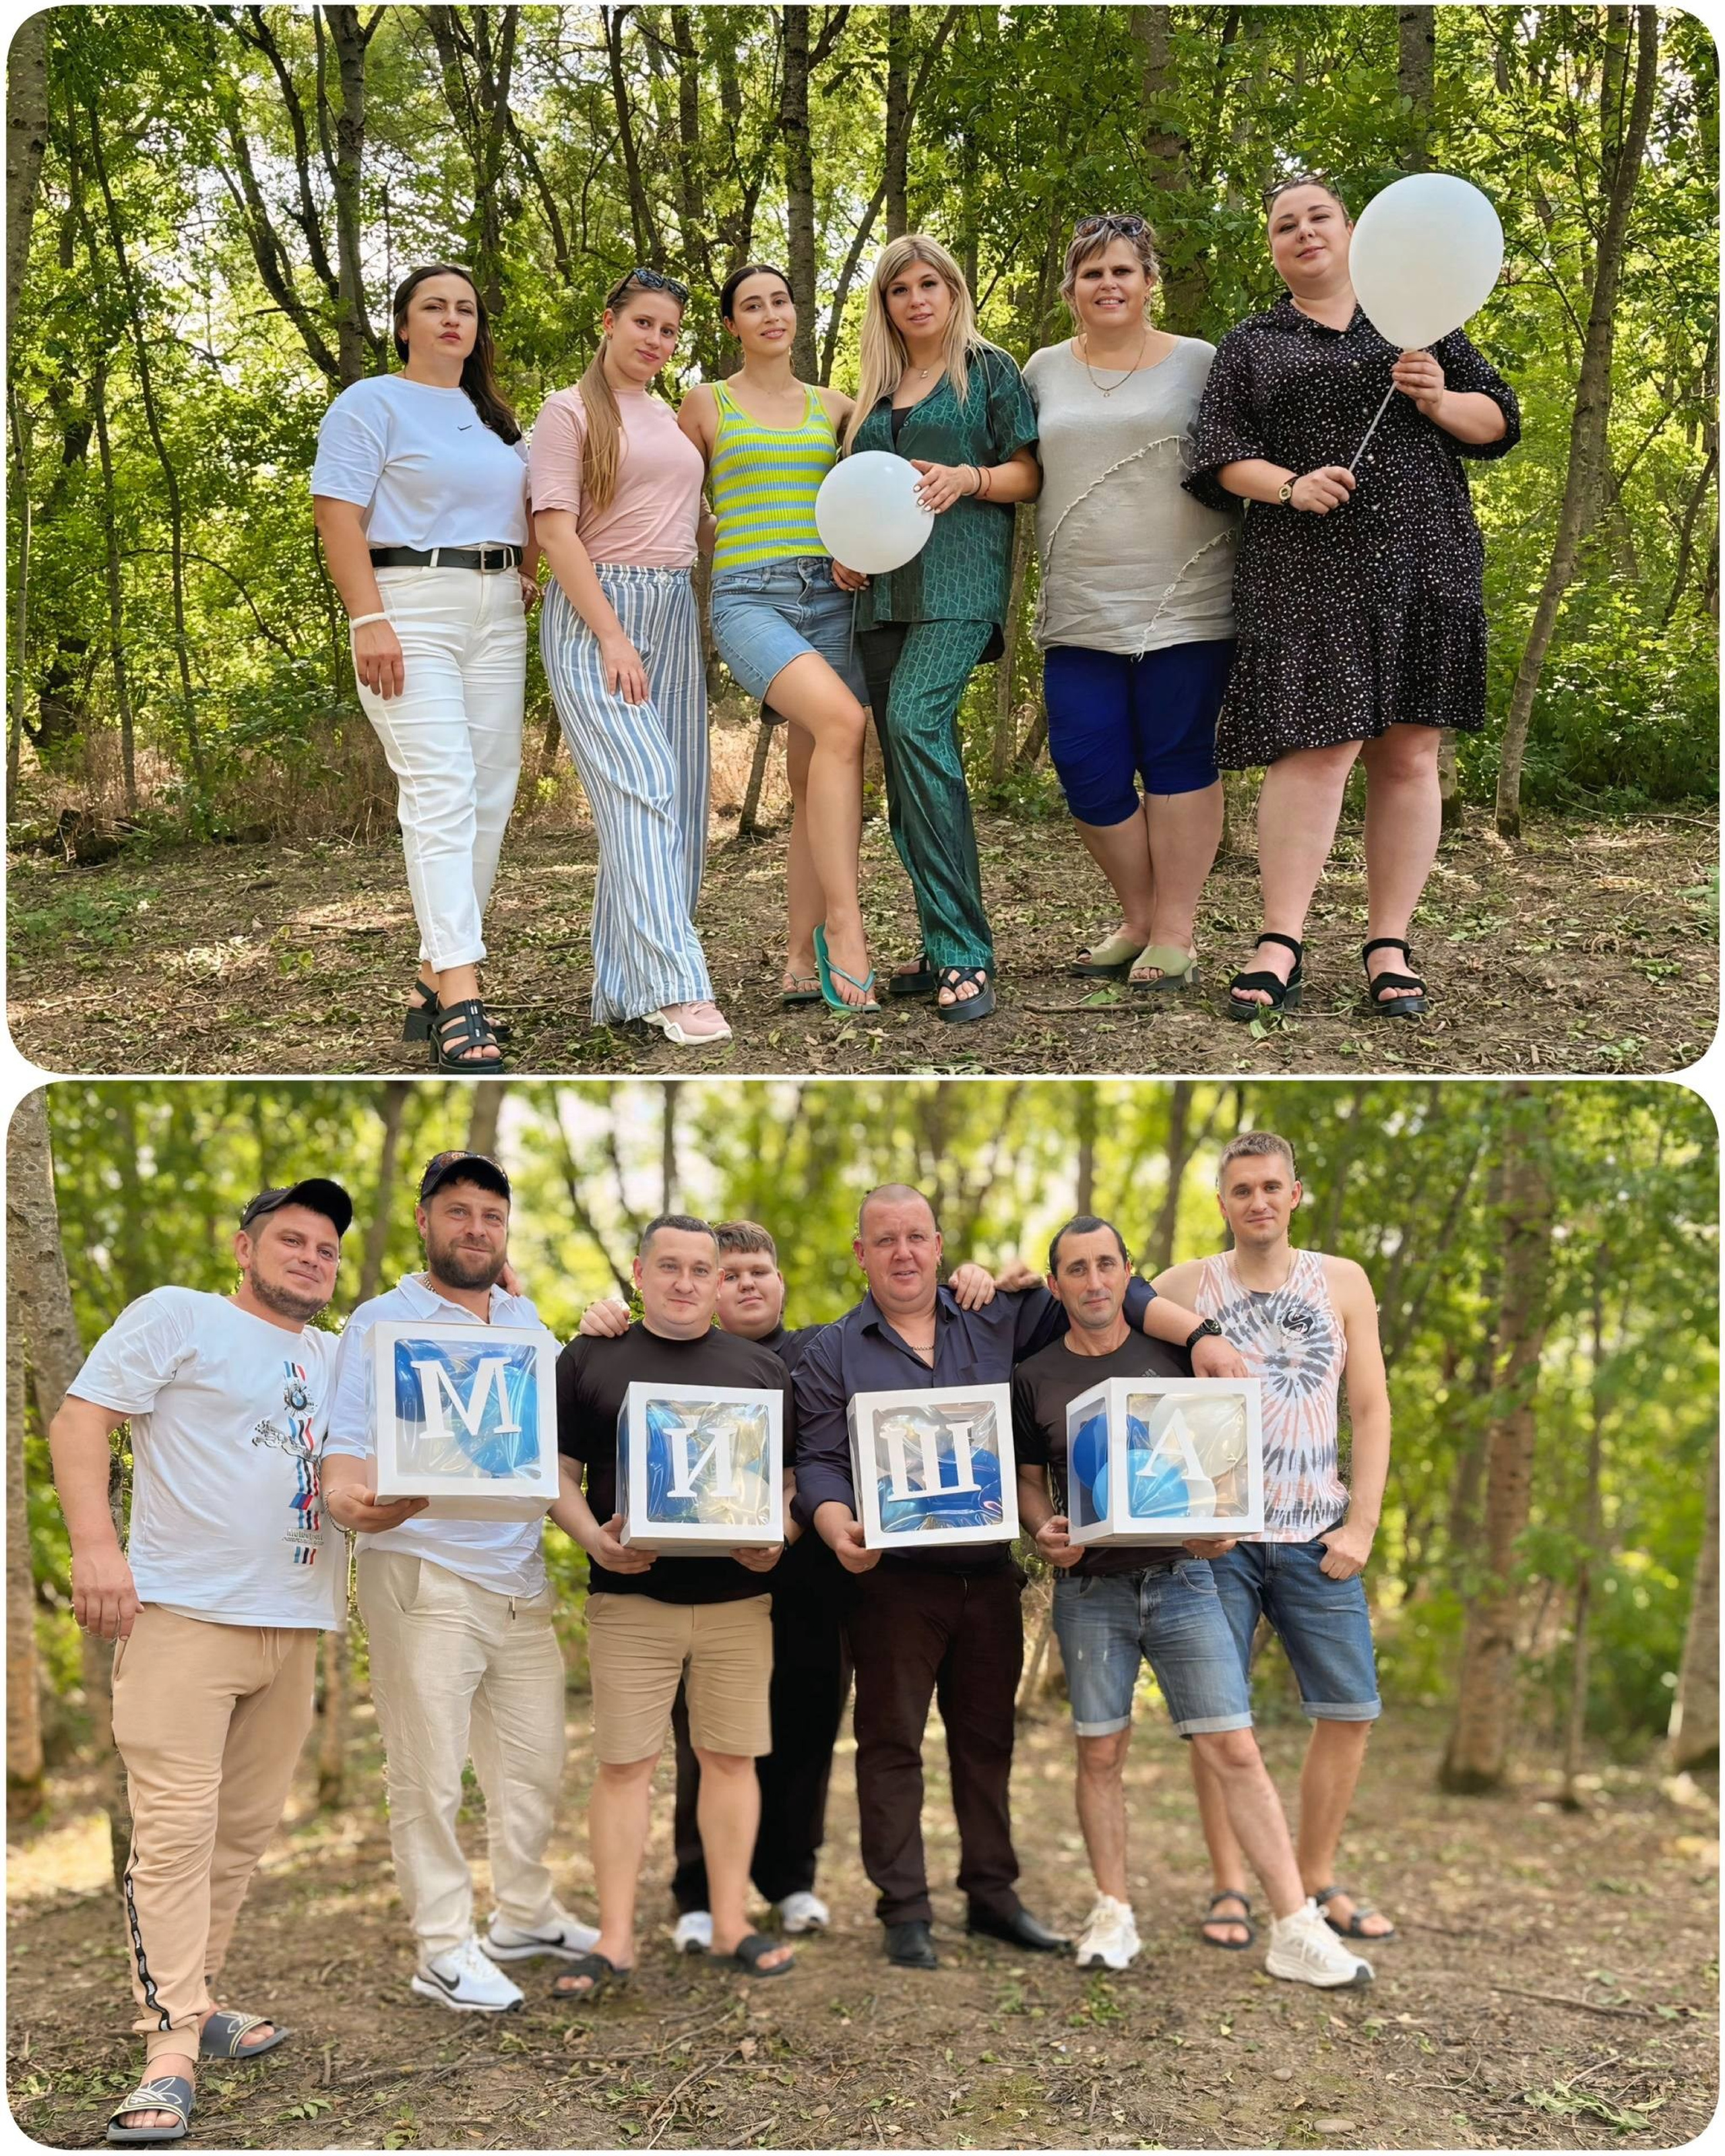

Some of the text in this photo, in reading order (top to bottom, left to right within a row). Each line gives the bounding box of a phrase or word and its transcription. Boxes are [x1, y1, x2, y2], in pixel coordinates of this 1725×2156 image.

[410, 1356, 522, 1440] М
[663, 1426, 739, 1498] И
[879, 1421, 982, 1502] Ш
[1135, 1407, 1210, 1482] А
